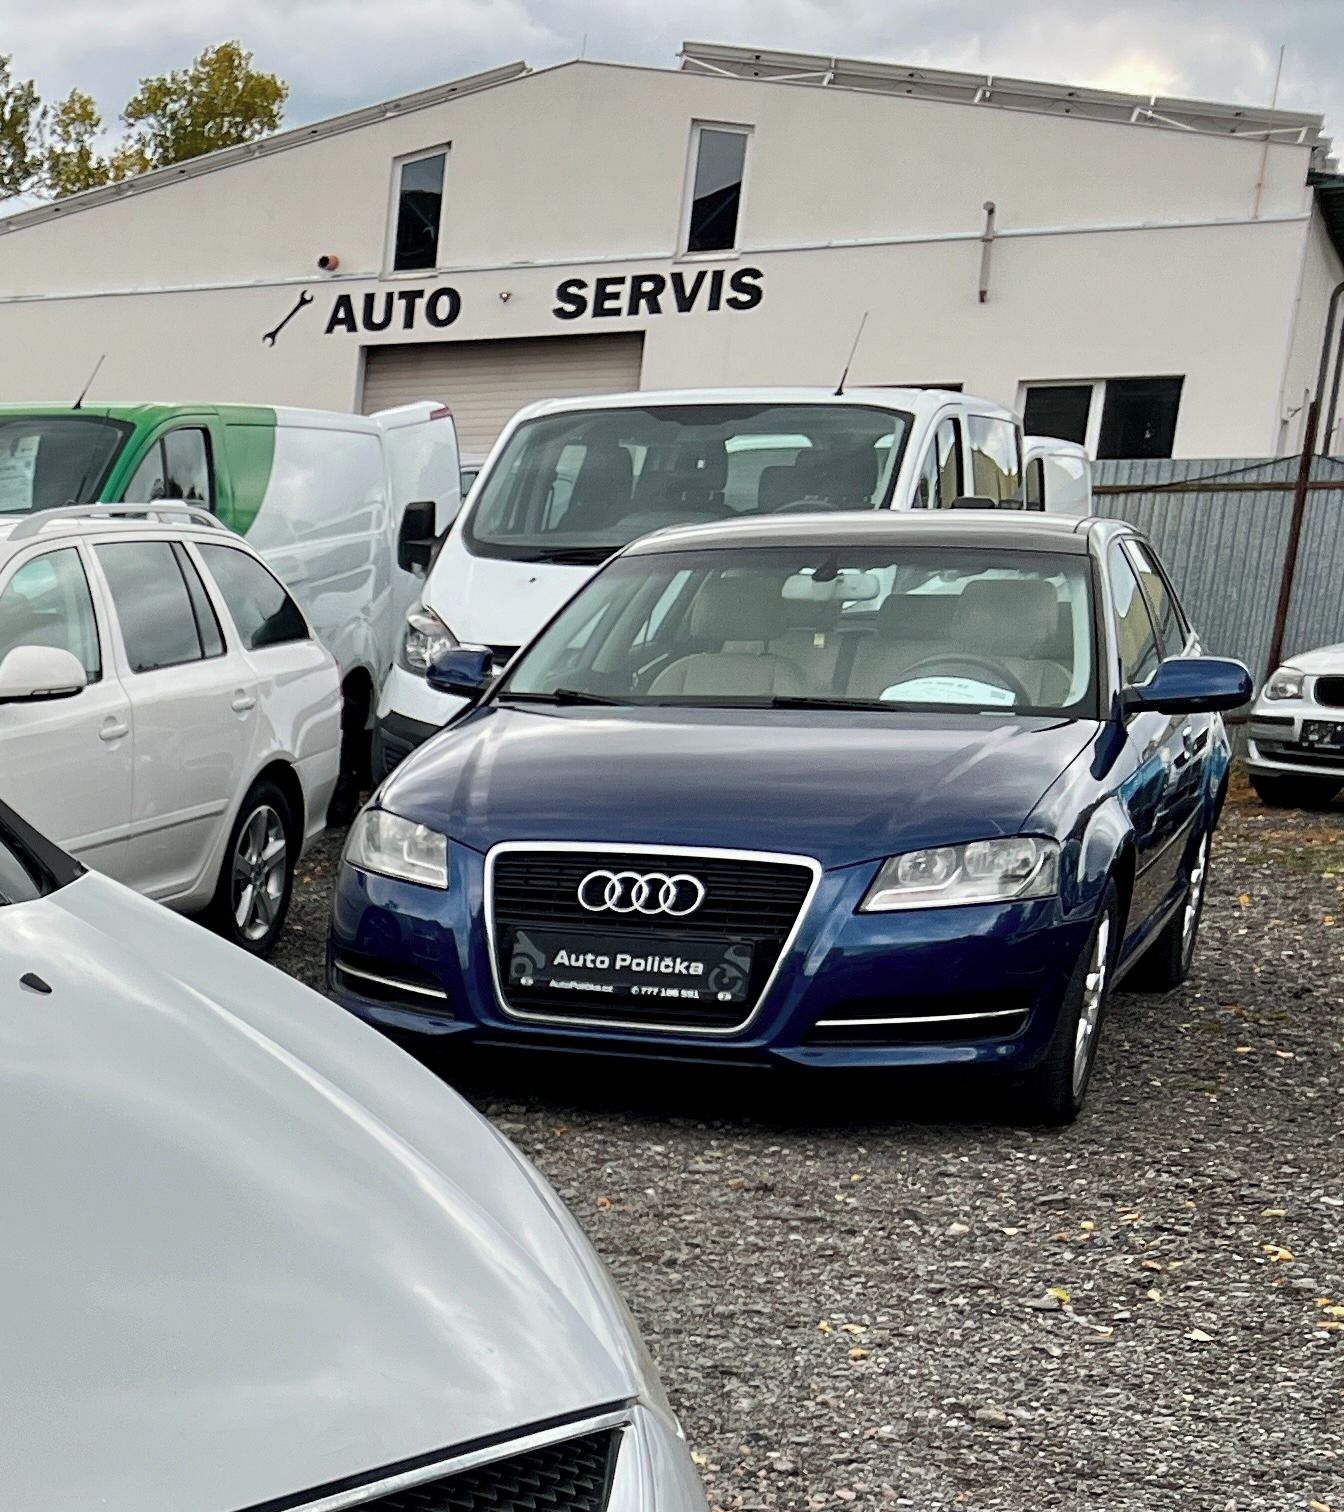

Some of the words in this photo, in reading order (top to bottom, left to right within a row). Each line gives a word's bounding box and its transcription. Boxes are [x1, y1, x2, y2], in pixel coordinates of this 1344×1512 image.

[324, 286, 462, 336] AUTO
[552, 267, 765, 321] SERVIS
[552, 949, 610, 969] Auto
[615, 953, 704, 976] Polička
